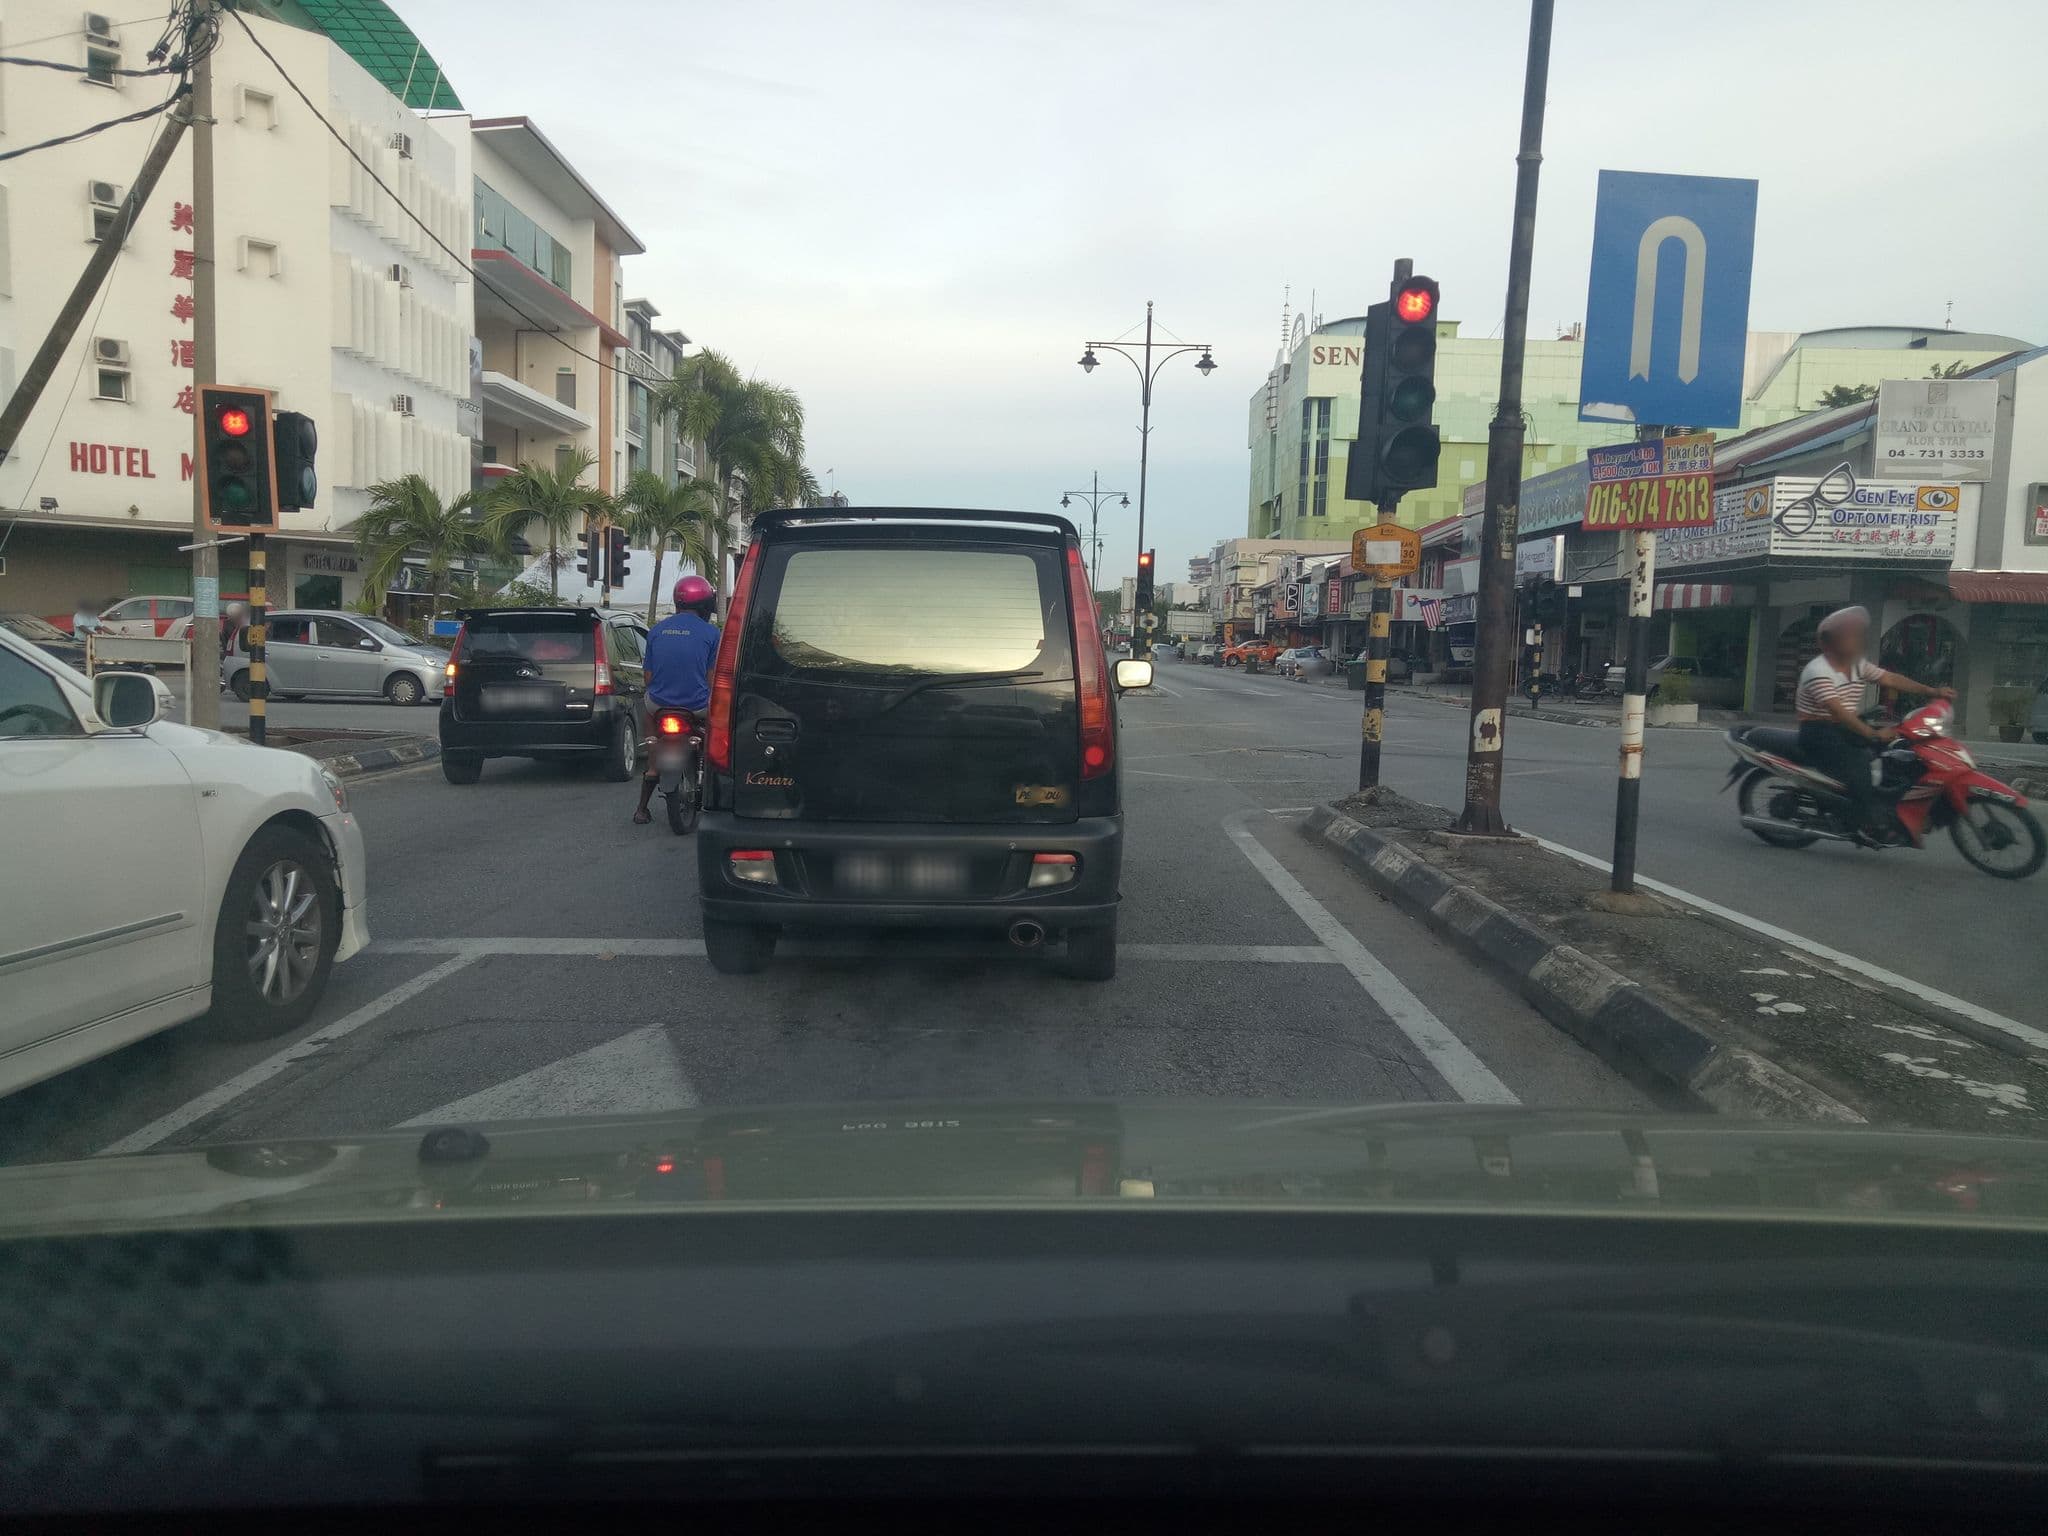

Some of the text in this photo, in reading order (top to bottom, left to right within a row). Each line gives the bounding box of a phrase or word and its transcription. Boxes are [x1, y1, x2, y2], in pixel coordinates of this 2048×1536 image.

[1313, 346, 1361, 366] SEN
[1880, 420, 1992, 433] GRAND CRYSTAL
[1906, 436, 1936, 446] ALOR
[1667, 443, 1710, 460] Tukar Cek
[1888, 449, 1906, 458] 04
[1919, 449, 1944, 458] 731
[1949, 449, 1985, 458] 3333
[70, 441, 156, 478] HOTEL
[1642, 460, 1660, 473] 10K
[1588, 479, 1659, 525] 016-374
[1665, 476, 1710, 522] 7313
[1934, 548, 1953, 556] Mata
[745, 770, 796, 786] Kenari
